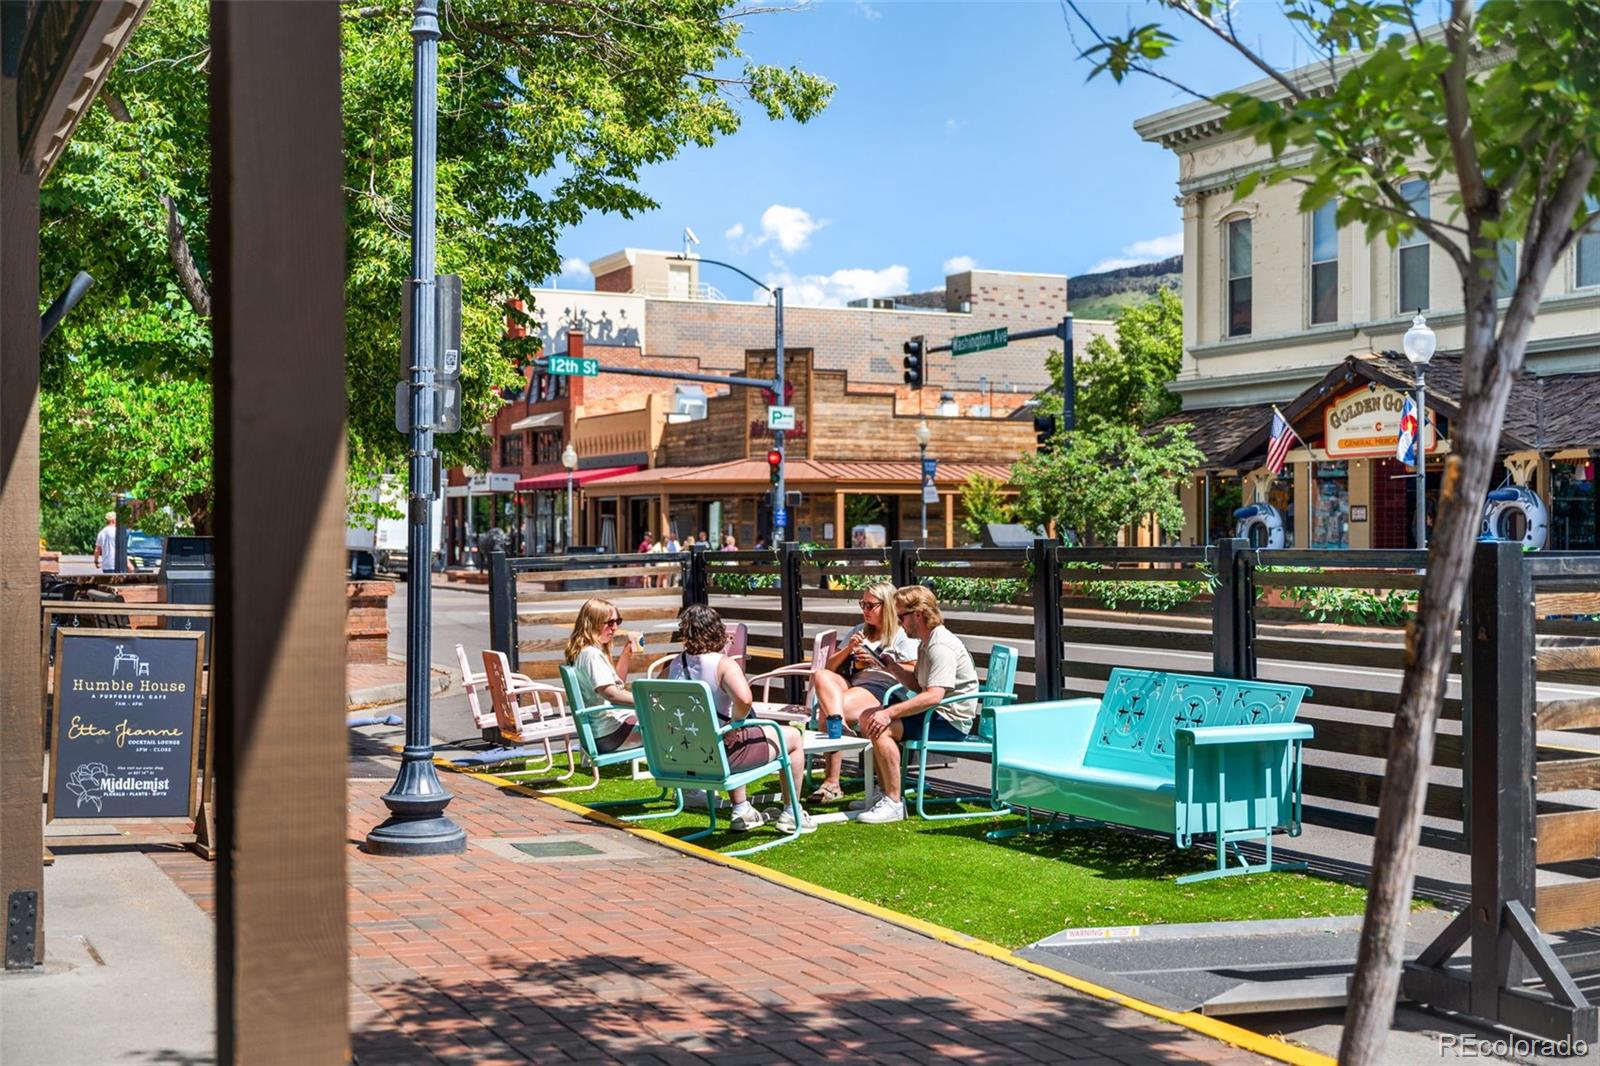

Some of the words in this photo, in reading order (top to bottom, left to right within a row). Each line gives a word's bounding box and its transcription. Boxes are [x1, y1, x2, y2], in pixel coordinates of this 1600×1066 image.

[551, 358, 579, 373] 12th
[583, 360, 597, 375] St
[772, 410, 783, 425] P
[1329, 396, 1380, 429] GOLDEN
[72, 679, 134, 691] Humble
[139, 680, 186, 692] House
[68, 715, 111, 740] Etta
[115, 719, 183, 748] Jeanne
[100, 777, 170, 793] Middlemist
